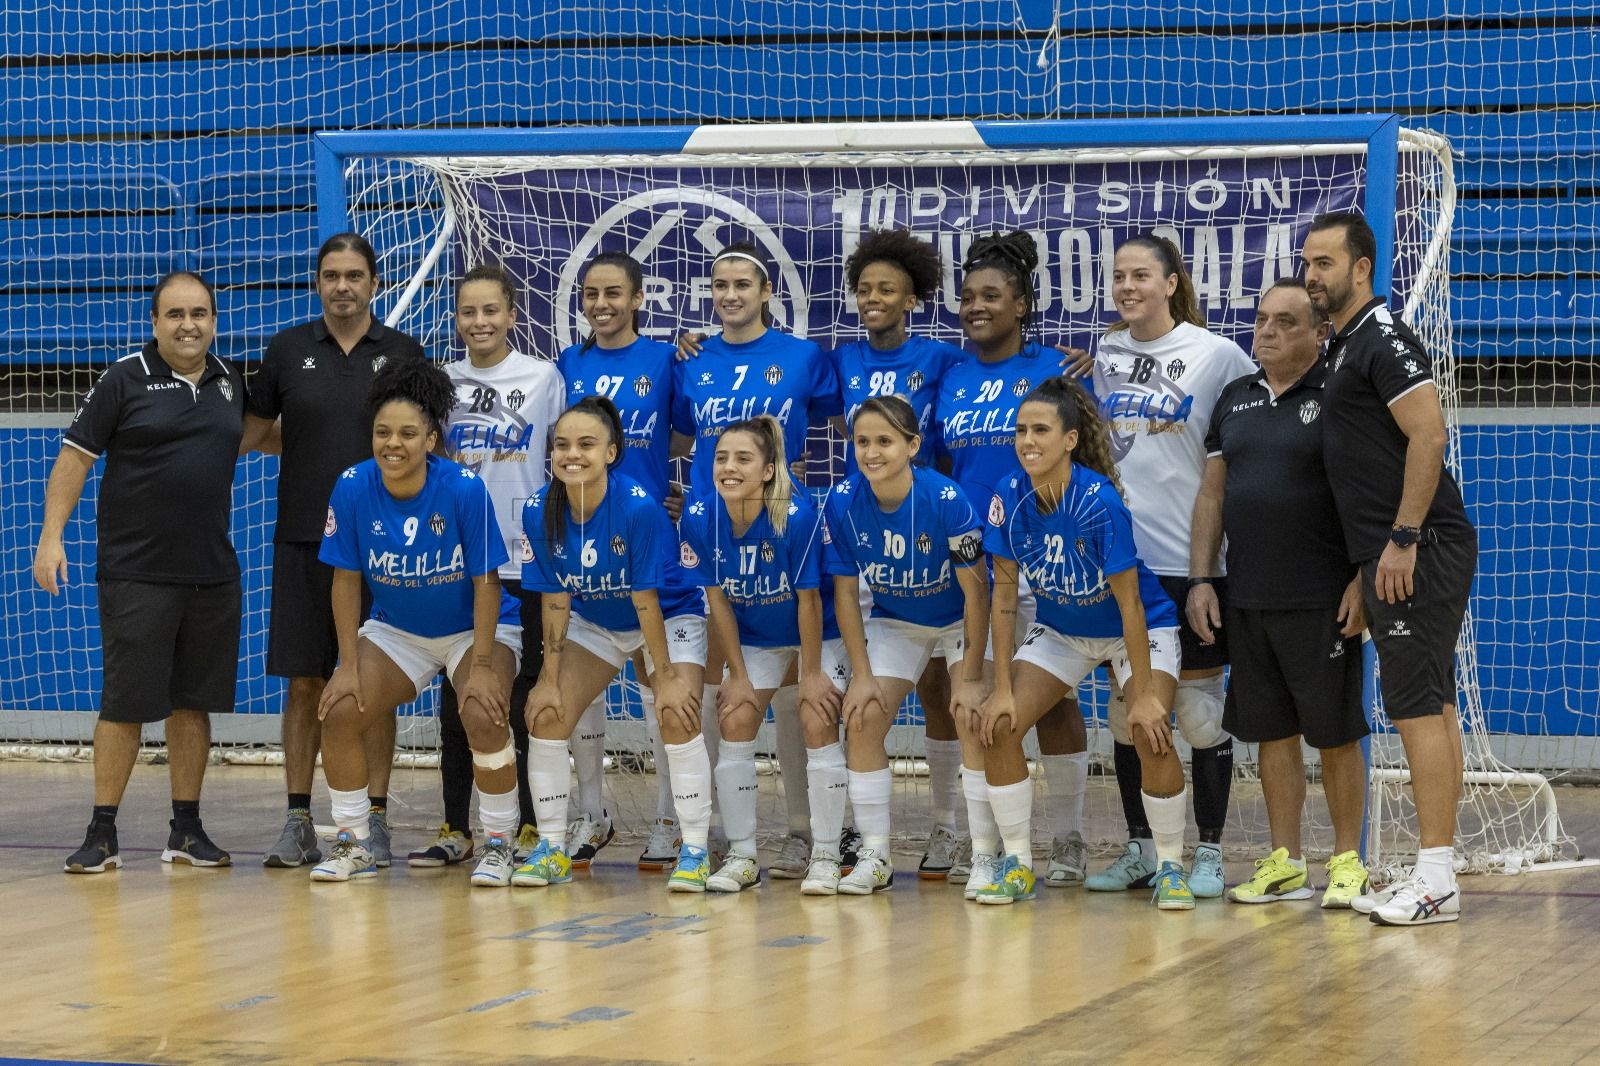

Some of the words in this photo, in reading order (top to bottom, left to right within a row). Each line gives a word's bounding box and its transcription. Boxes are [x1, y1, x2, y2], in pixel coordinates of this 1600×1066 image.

[912, 167, 1291, 216] DIVISIÓN
[732, 365, 749, 391] 7
[1128, 357, 1155, 384] 18
[146, 382, 182, 392] KELME
[595, 375, 624, 400] 97
[868, 371, 897, 397] 98
[973, 379, 1004, 404] 20
[468, 387, 496, 413] 28
[694, 396, 793, 426] MELILLA
[1232, 399, 1265, 412] KELME
[943, 408, 1017, 439] MELILL
[971, 436, 988, 447] DEL
[991, 434, 1016, 446] DEPO
[403, 516, 419, 546] 9
[581, 539, 598, 568] 6
[883, 529, 906, 560] 10
[1044, 533, 1064, 563] 22
[368, 543, 465, 577] MELILLA
[739, 545, 758, 575] 17
[371, 573, 401, 587] CIUDAD
[404, 577, 423, 588] DEL
[427, 572, 465, 587] DEPORTE
[556, 567, 631, 593] MELILL
[891, 590, 910, 598] DEL
[914, 582, 951, 597] DEPORTE
[592, 592, 609, 601] DEL
[761, 593, 794, 606] DEPORTE
[539, 793, 568, 802] KELME
